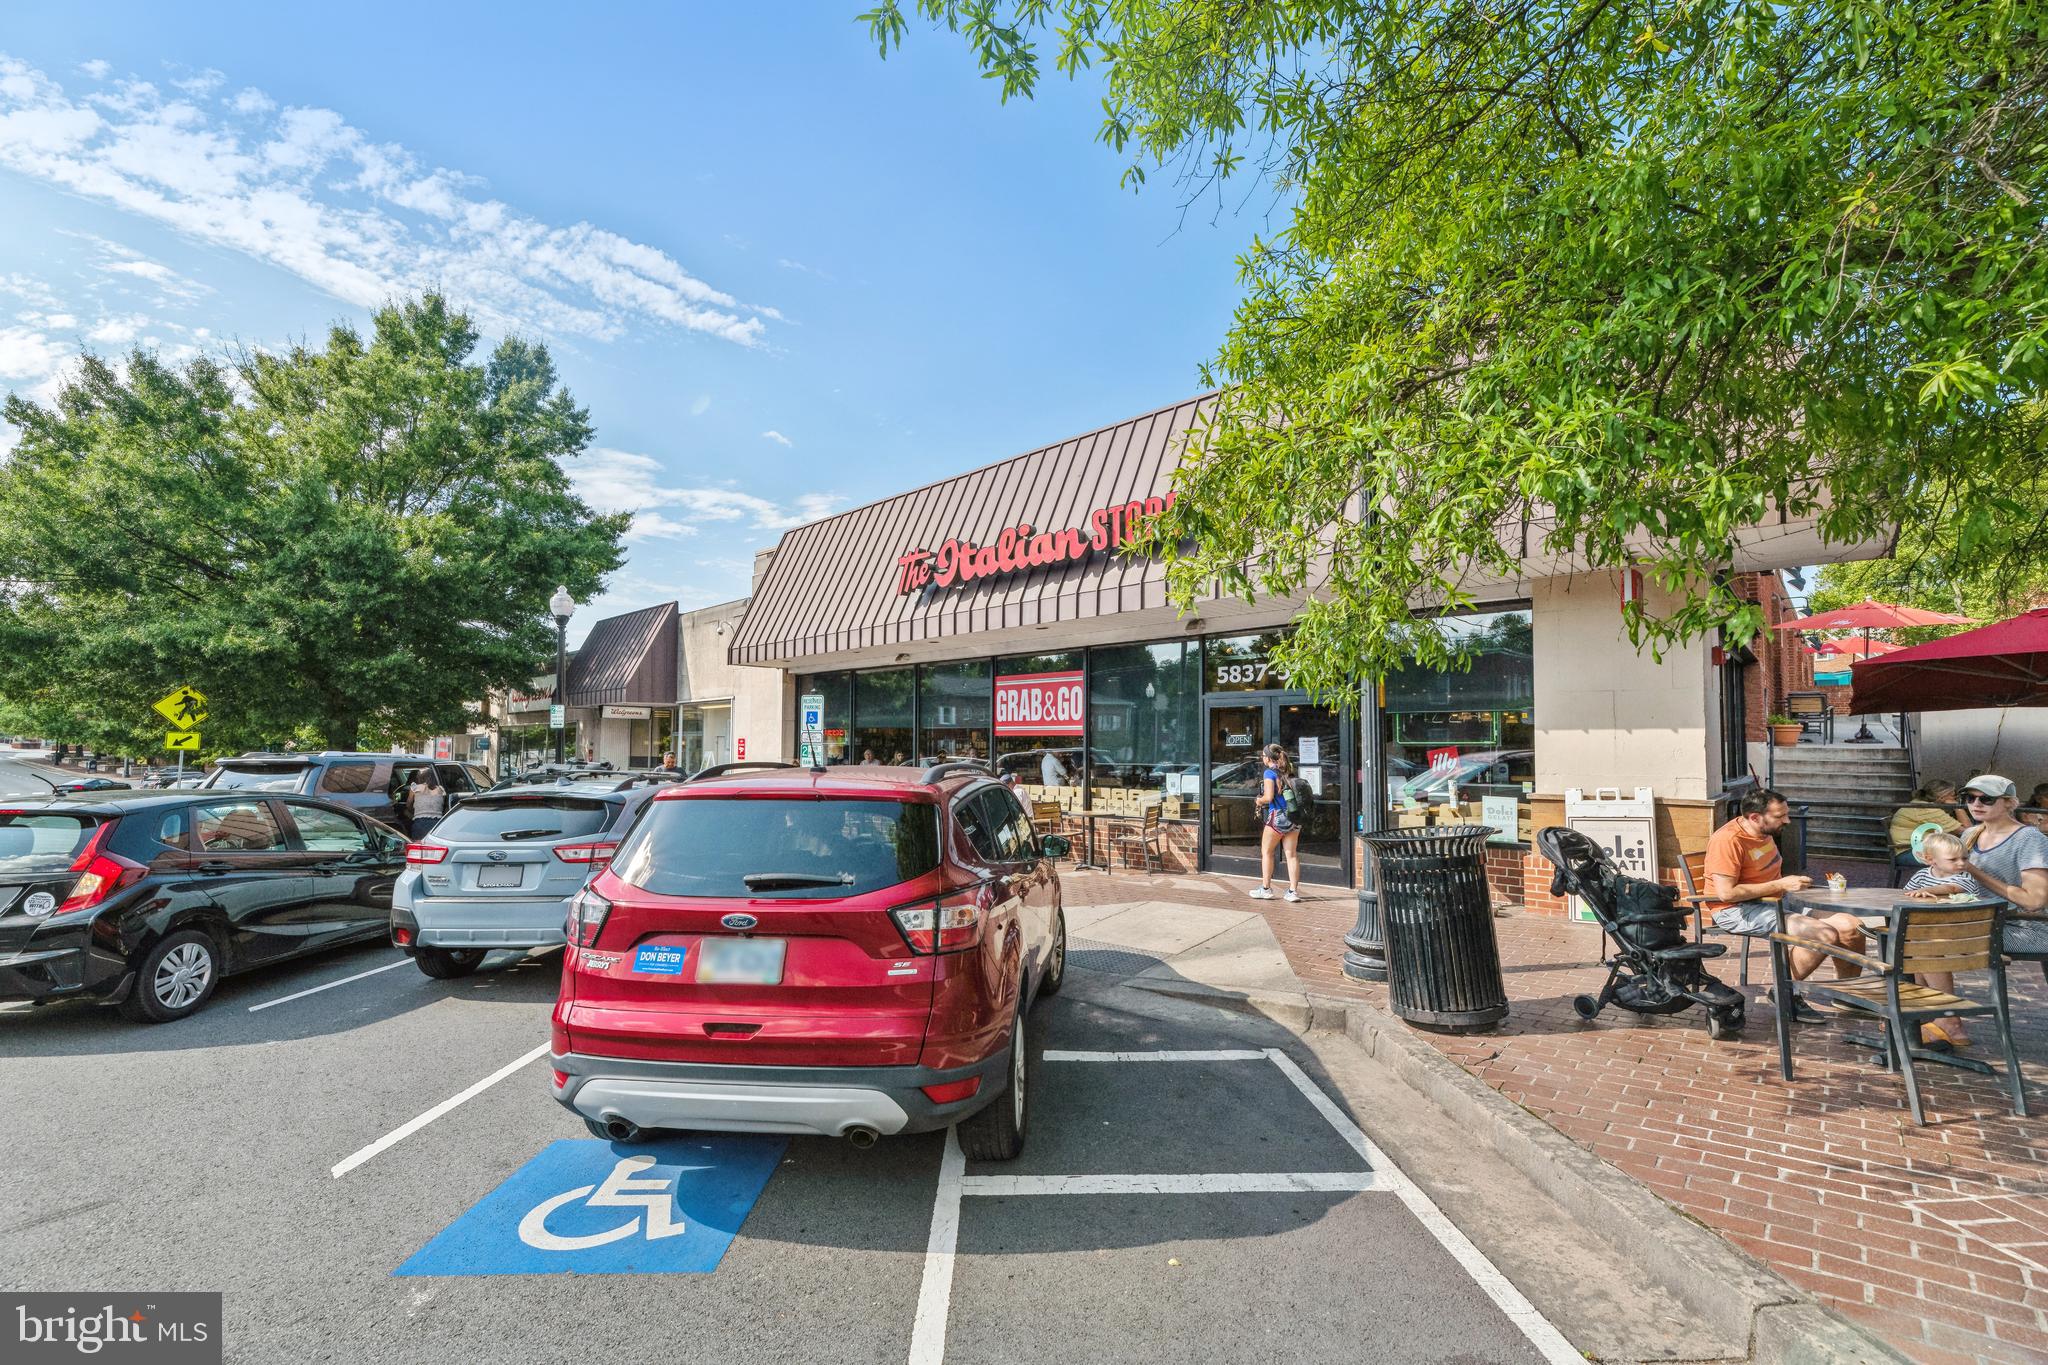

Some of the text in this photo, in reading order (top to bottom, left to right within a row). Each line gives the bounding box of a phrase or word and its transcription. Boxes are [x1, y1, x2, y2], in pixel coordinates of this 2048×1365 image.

[897, 547, 931, 596] The
[933, 523, 1088, 588] Italian
[996, 685, 1083, 722] GRAB&GO
[1228, 735, 1250, 745] OPEN
[802, 746, 808, 756] 2
[1431, 752, 1457, 774] illy
[1486, 804, 1513, 815] Dolci
[1602, 835, 1645, 859] olci
[1618, 860, 1646, 872] ATI
[728, 915, 749, 926] Ford
[581, 952, 621, 963] ESCAPE
[640, 951, 681, 963] DON BEYER
